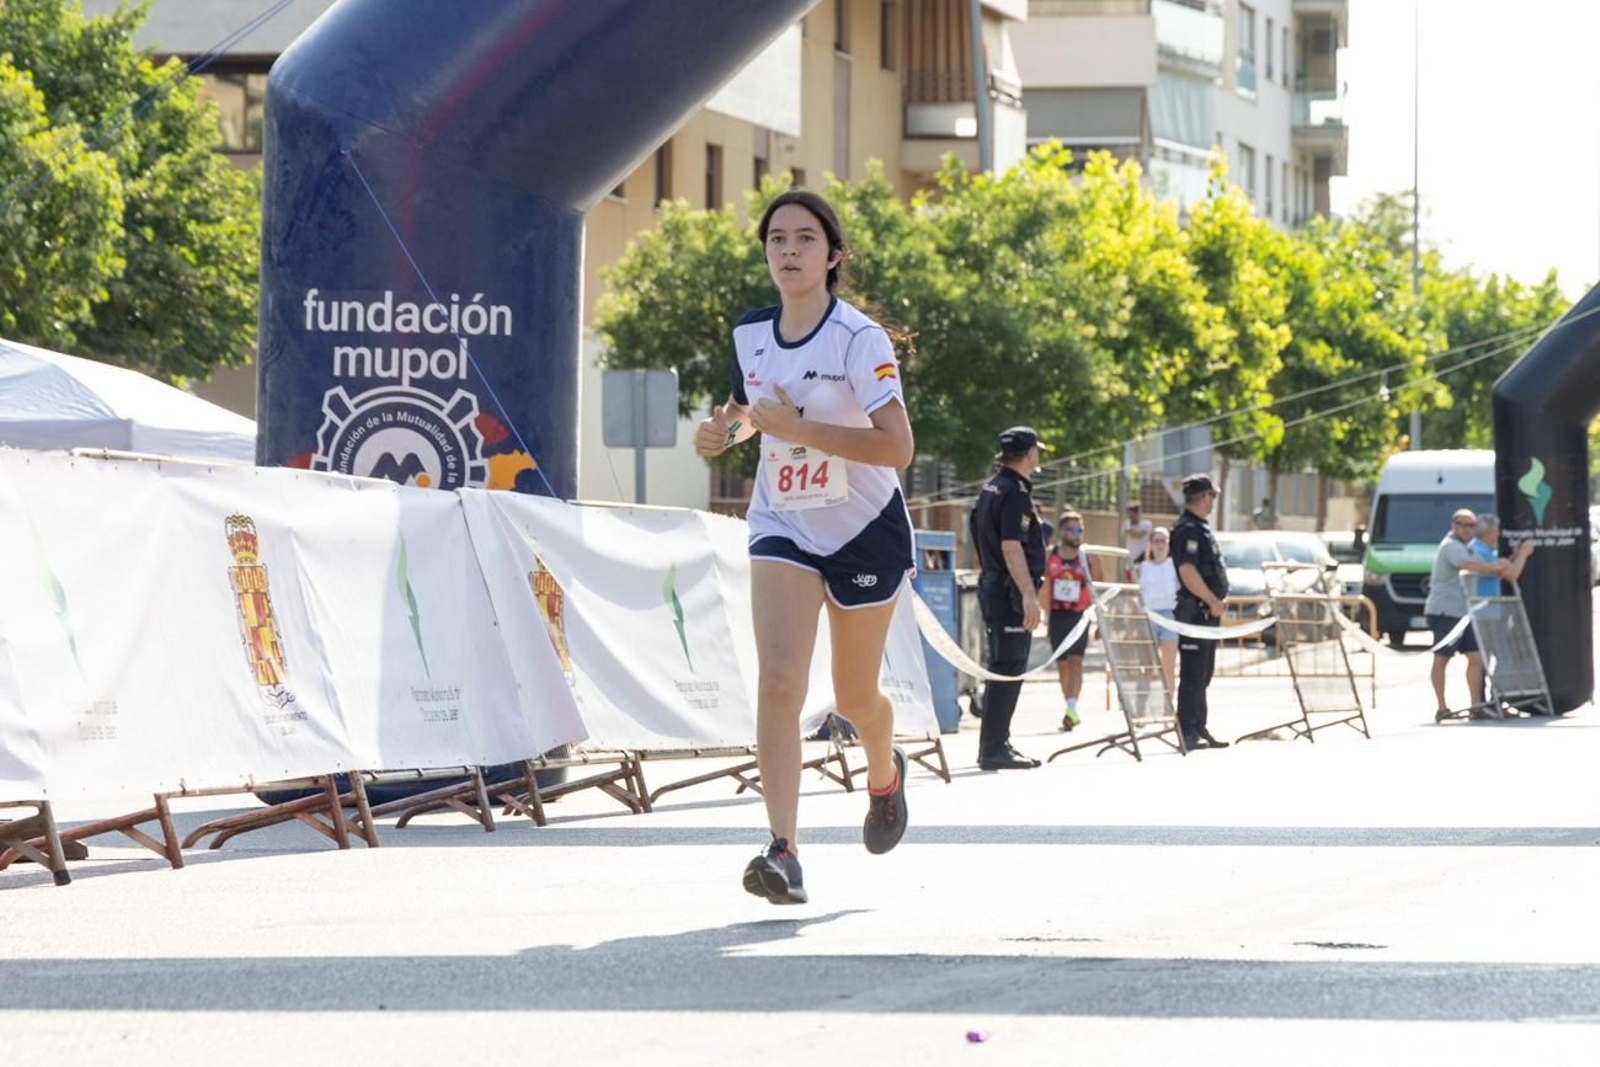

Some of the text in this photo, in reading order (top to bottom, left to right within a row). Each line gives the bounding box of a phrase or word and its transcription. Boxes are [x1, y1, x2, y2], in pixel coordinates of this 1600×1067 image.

[303, 288, 512, 336] fundación
[332, 338, 468, 387] mupol
[339, 425, 366, 475] undación
[366, 416, 380, 428] de
[382, 412, 394, 422] la
[397, 411, 454, 453] Mutualidad
[446, 454, 458, 469] de
[778, 460, 829, 493] 814
